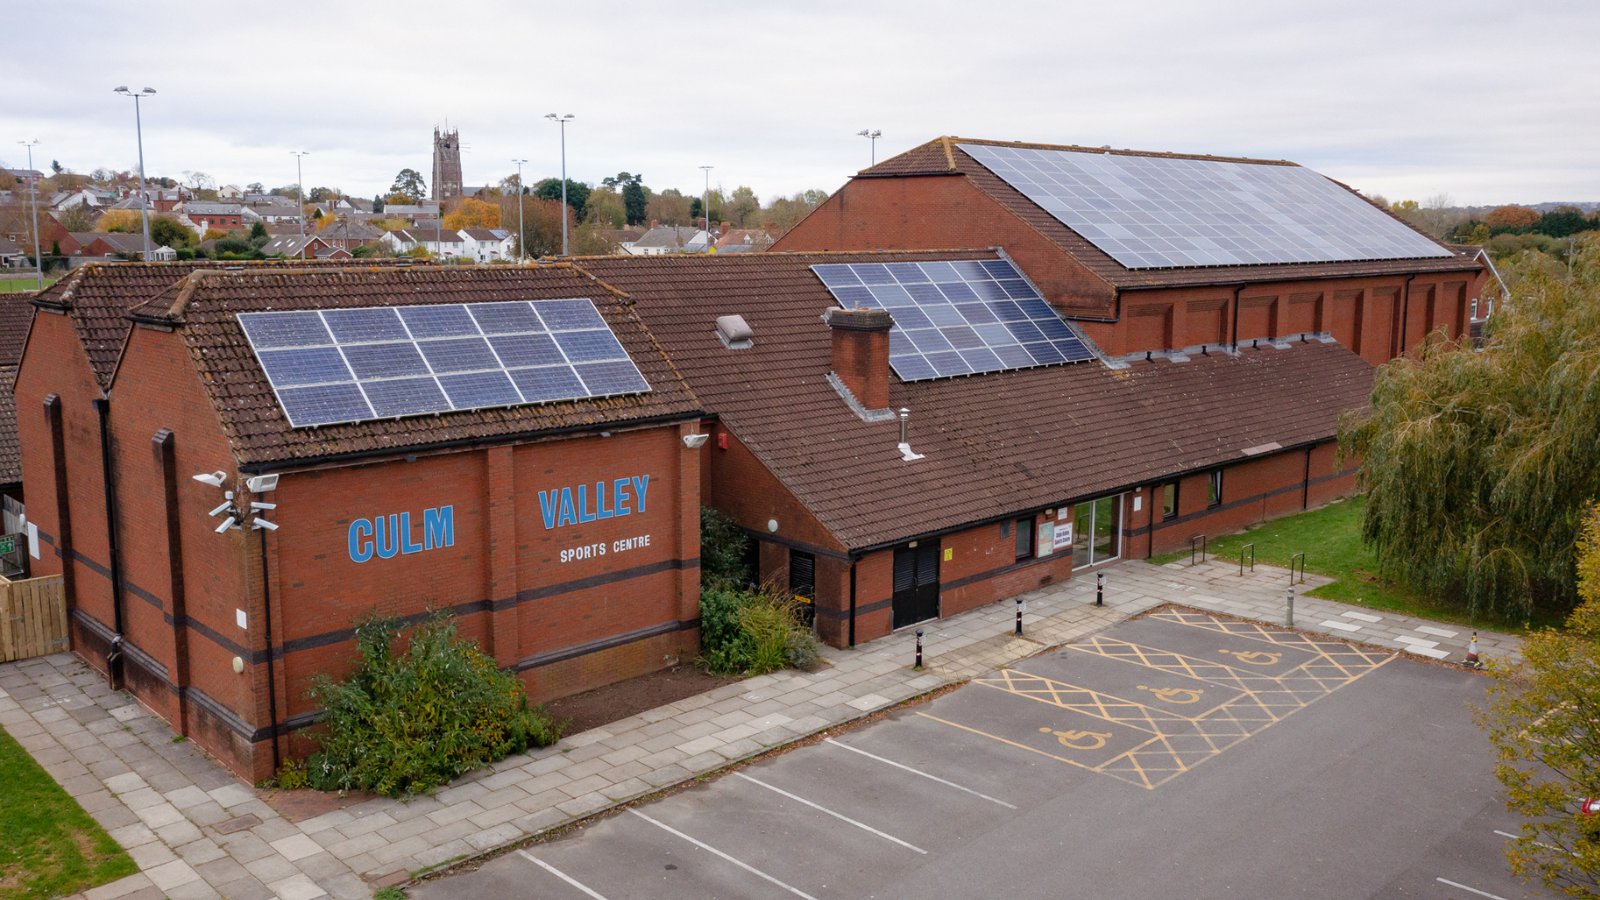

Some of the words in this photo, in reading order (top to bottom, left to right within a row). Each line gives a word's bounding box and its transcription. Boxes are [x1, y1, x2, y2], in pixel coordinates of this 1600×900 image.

[348, 505, 454, 563] CULM
[538, 474, 649, 530] VALLEY
[560, 543, 606, 563] SPORTS
[613, 535, 651, 553] CENTRE
